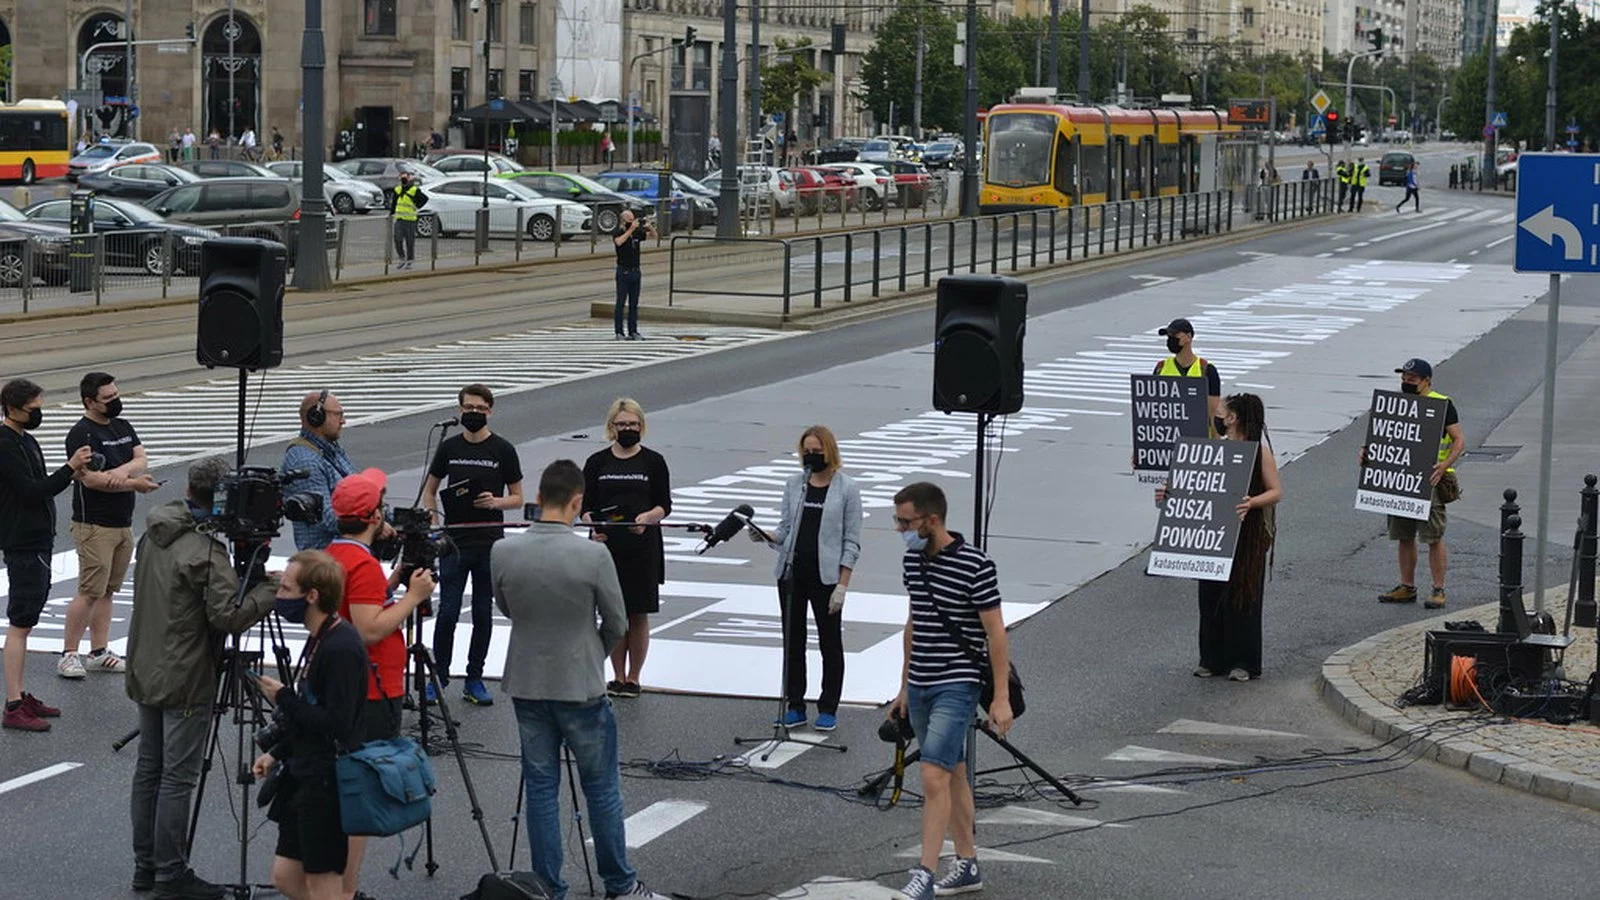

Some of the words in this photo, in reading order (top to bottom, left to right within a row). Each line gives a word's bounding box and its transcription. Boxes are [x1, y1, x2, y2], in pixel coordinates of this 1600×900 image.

[1136, 380, 1180, 398] DUDA
[1188, 387, 1197, 395] =
[1136, 401, 1189, 423] WĘGIEL
[1375, 395, 1418, 419] DUDA
[1425, 408, 1435, 417] =
[1137, 425, 1180, 443] SUSZA
[1372, 418, 1422, 442] WĘGIEL
[1138, 448, 1175, 466] POW
[1177, 443, 1224, 466] DUDA
[1232, 454, 1243, 463] =
[1367, 442, 1411, 466] SUSZA
[1172, 469, 1227, 495] WĘGIEL
[1363, 467, 1423, 494] POWÓDŹ
[1165, 498, 1213, 521] SUSZA
[1360, 494, 1424, 515] katastrofa2030.pl
[1159, 524, 1226, 551] POWÓDŹ
[1154, 557, 1226, 576] katastrofa2030.pl
